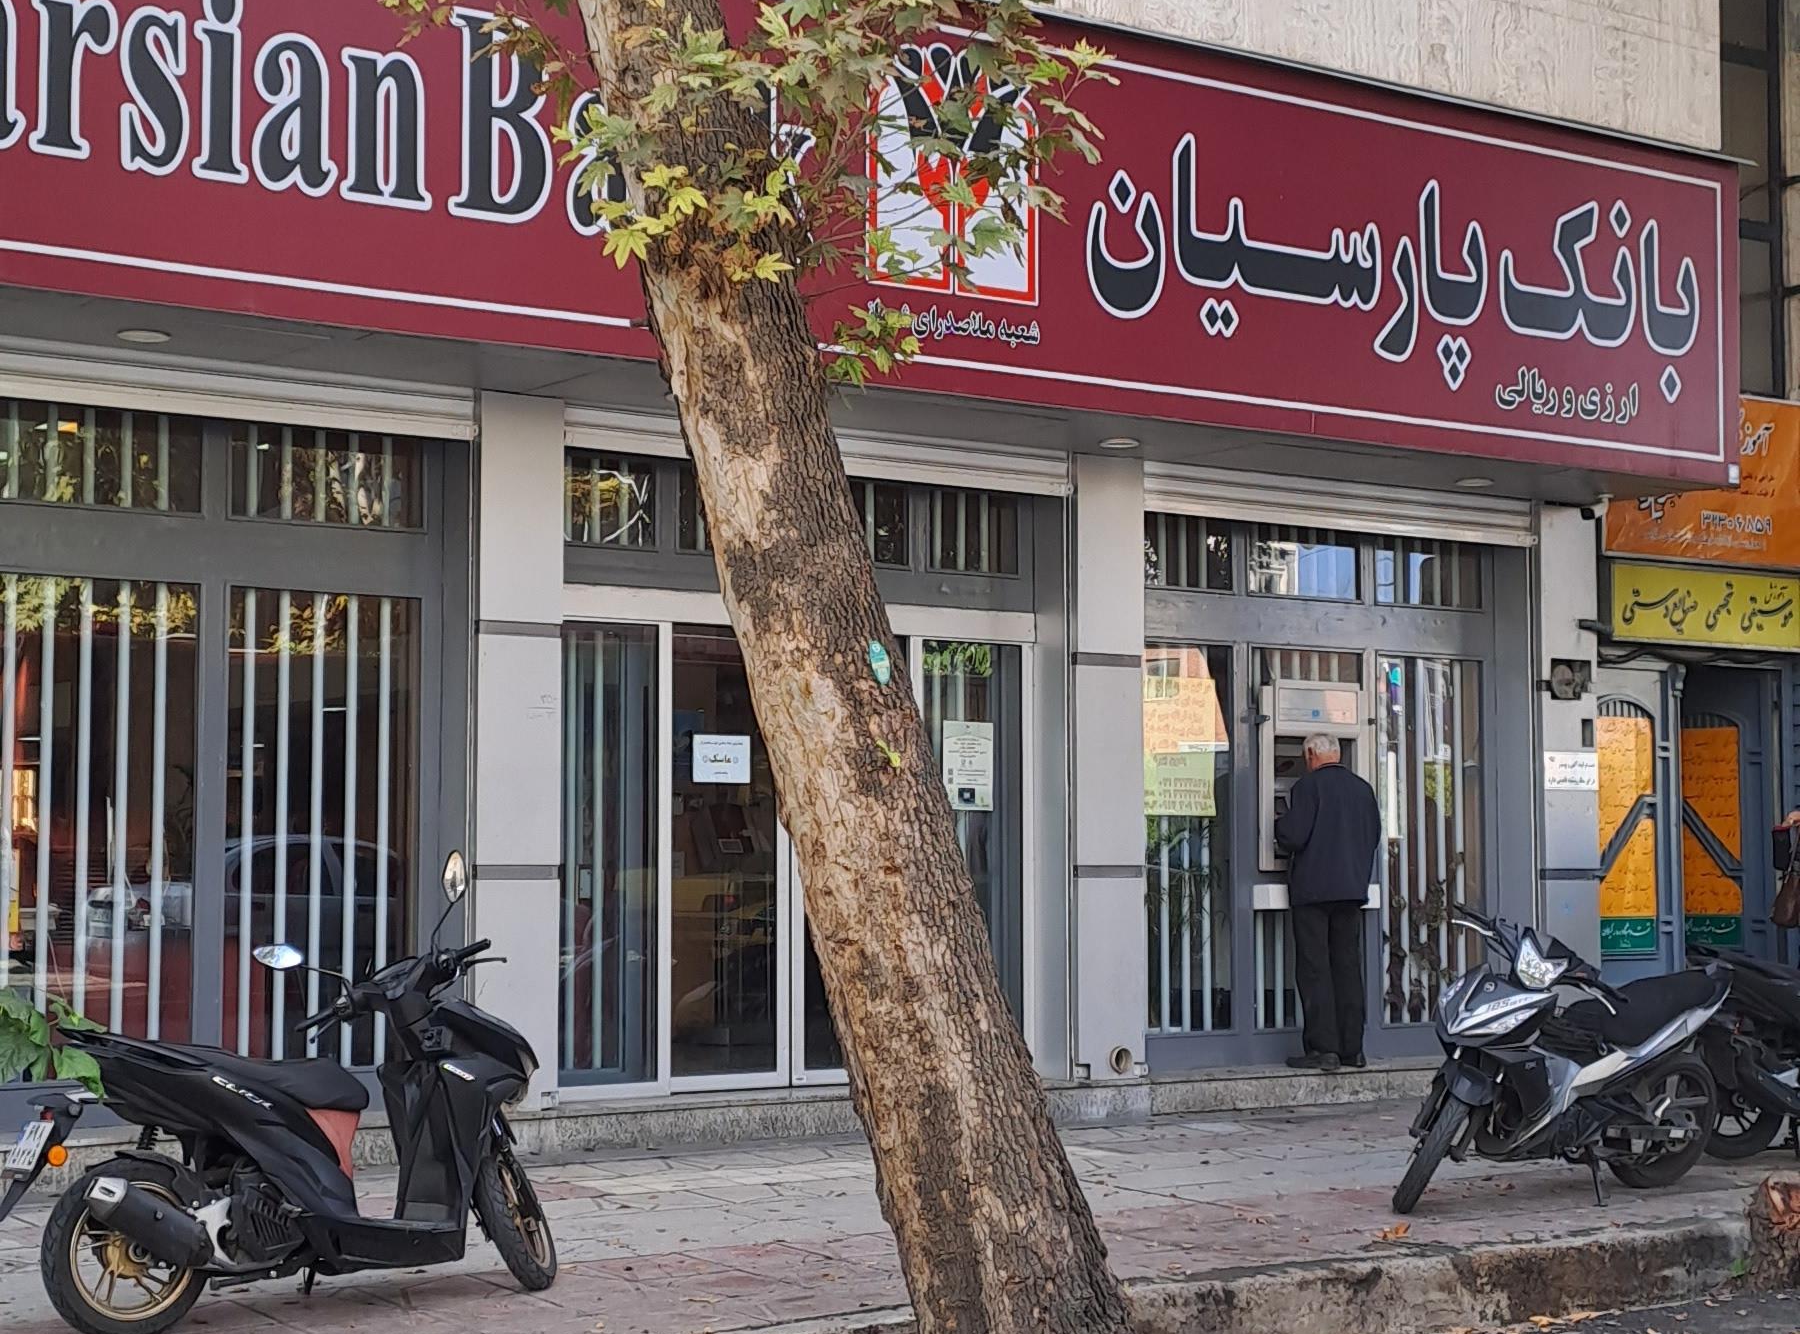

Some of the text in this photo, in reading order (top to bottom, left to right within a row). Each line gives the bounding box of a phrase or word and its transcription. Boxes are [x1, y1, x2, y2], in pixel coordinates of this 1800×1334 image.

[1086, 132, 1700, 404] بانک پارسیان
[997, 317, 1041, 349] شعبه
[1495, 365, 1639, 424] ارزی و ریالی
[1621, 587, 1680, 626] دستی
[1740, 595, 1794, 634] موسیقی
